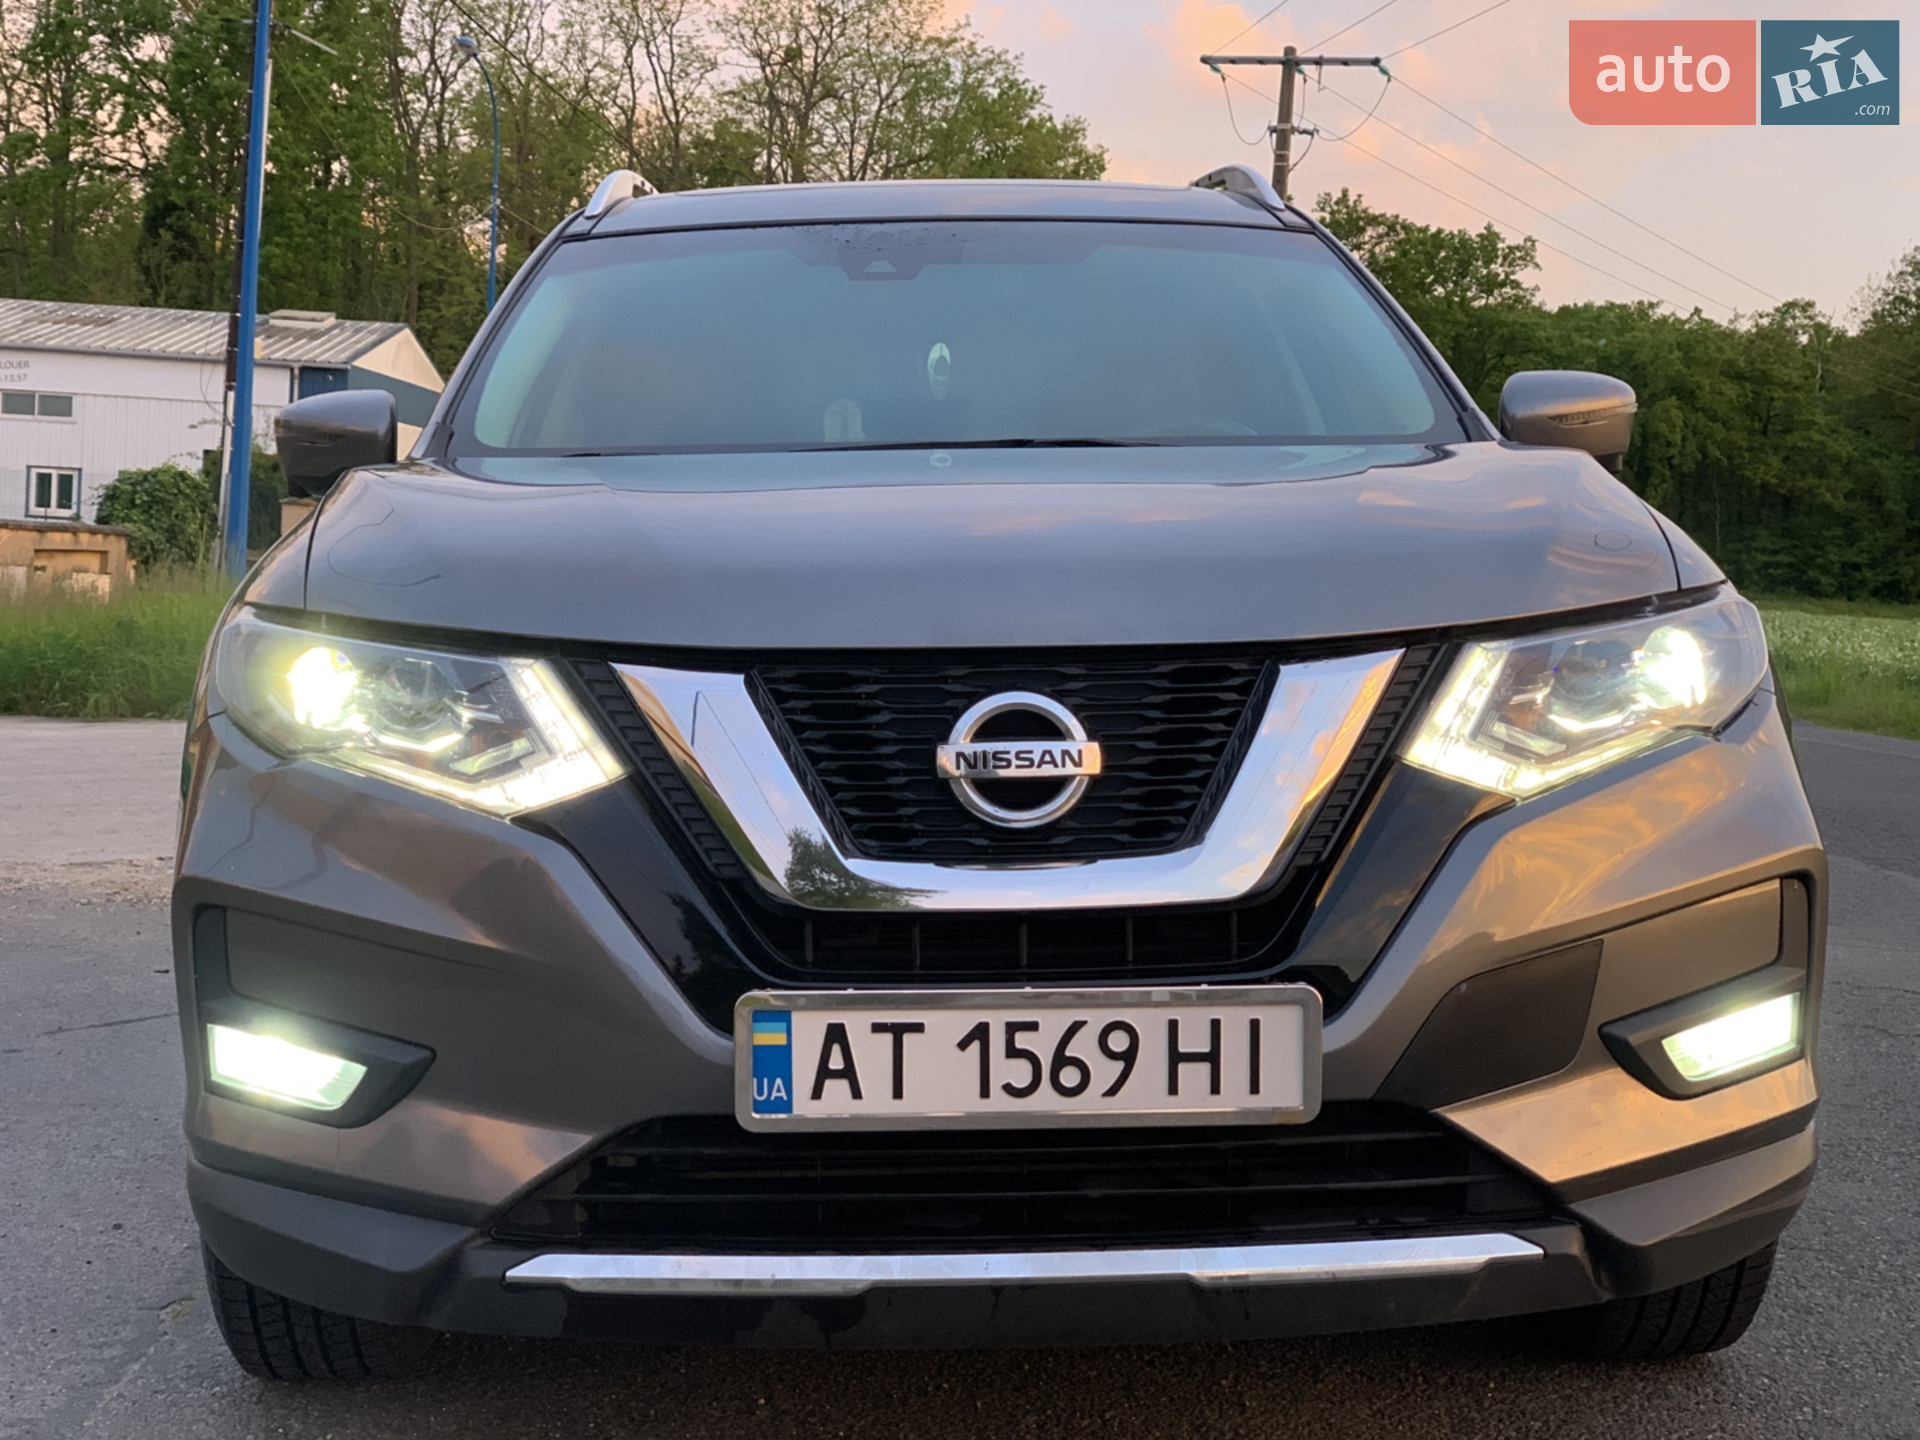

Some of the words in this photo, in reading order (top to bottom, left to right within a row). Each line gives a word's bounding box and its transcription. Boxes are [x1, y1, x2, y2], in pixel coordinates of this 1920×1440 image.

[955, 749, 1083, 770] NISSAN
[810, 1021, 925, 1100] AT
[956, 1019, 1140, 1099] 1569
[1167, 1017, 1261, 1096] HI
[753, 1077, 788, 1101] UA
